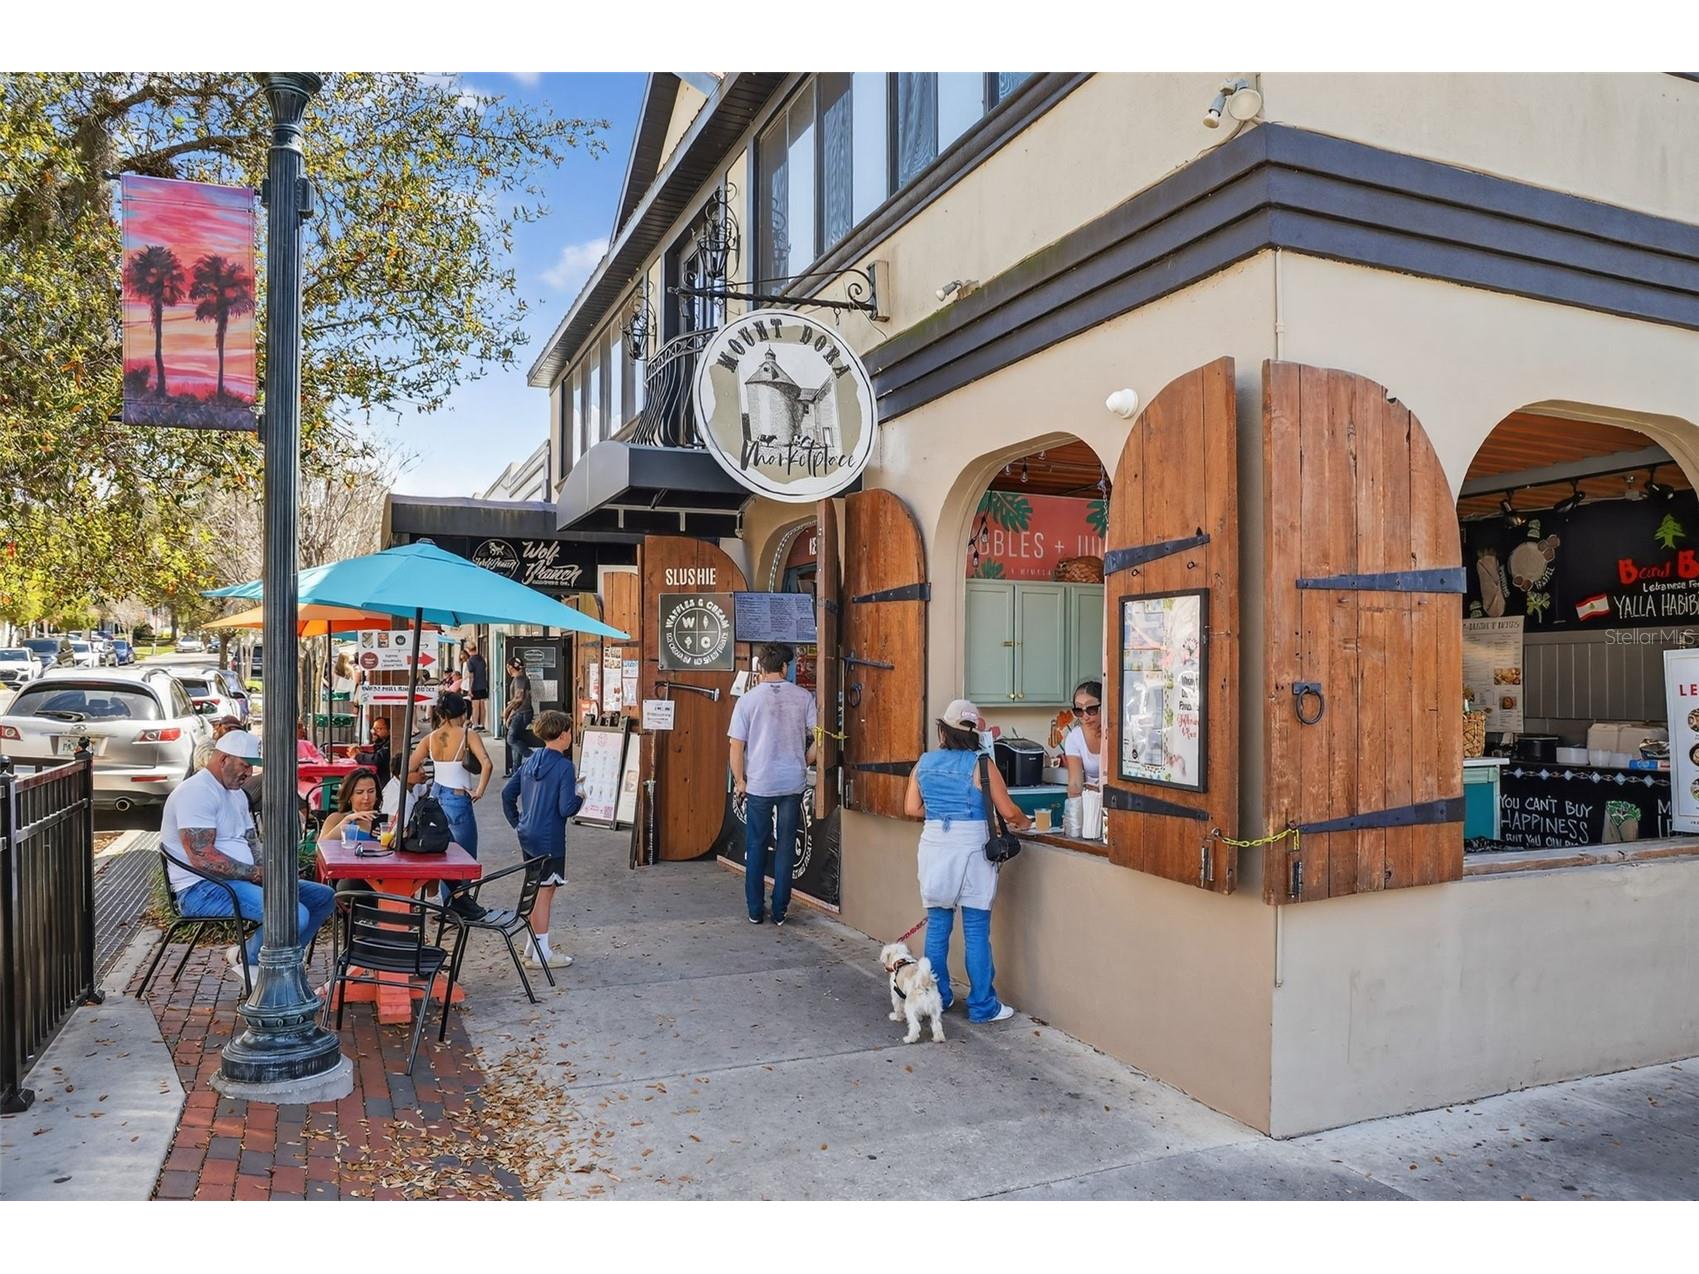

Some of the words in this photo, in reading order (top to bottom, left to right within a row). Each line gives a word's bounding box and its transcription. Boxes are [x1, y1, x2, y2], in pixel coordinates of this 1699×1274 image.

[716, 318, 783, 374] MOUNT
[799, 324, 852, 380] DORA
[740, 436, 856, 478] Marketplace
[521, 540, 561, 566] Wolf
[521, 559, 583, 588] Branch
[665, 567, 717, 586] SLUSHIE
[664, 598, 696, 629] WAFFLES
[705, 600, 731, 629] CREAM
[1613, 594, 1657, 619] YALLA
[1500, 793, 1520, 809] YOU
[1565, 800, 1593, 819] BUY
[1500, 809, 1589, 844] HAPPINESS
